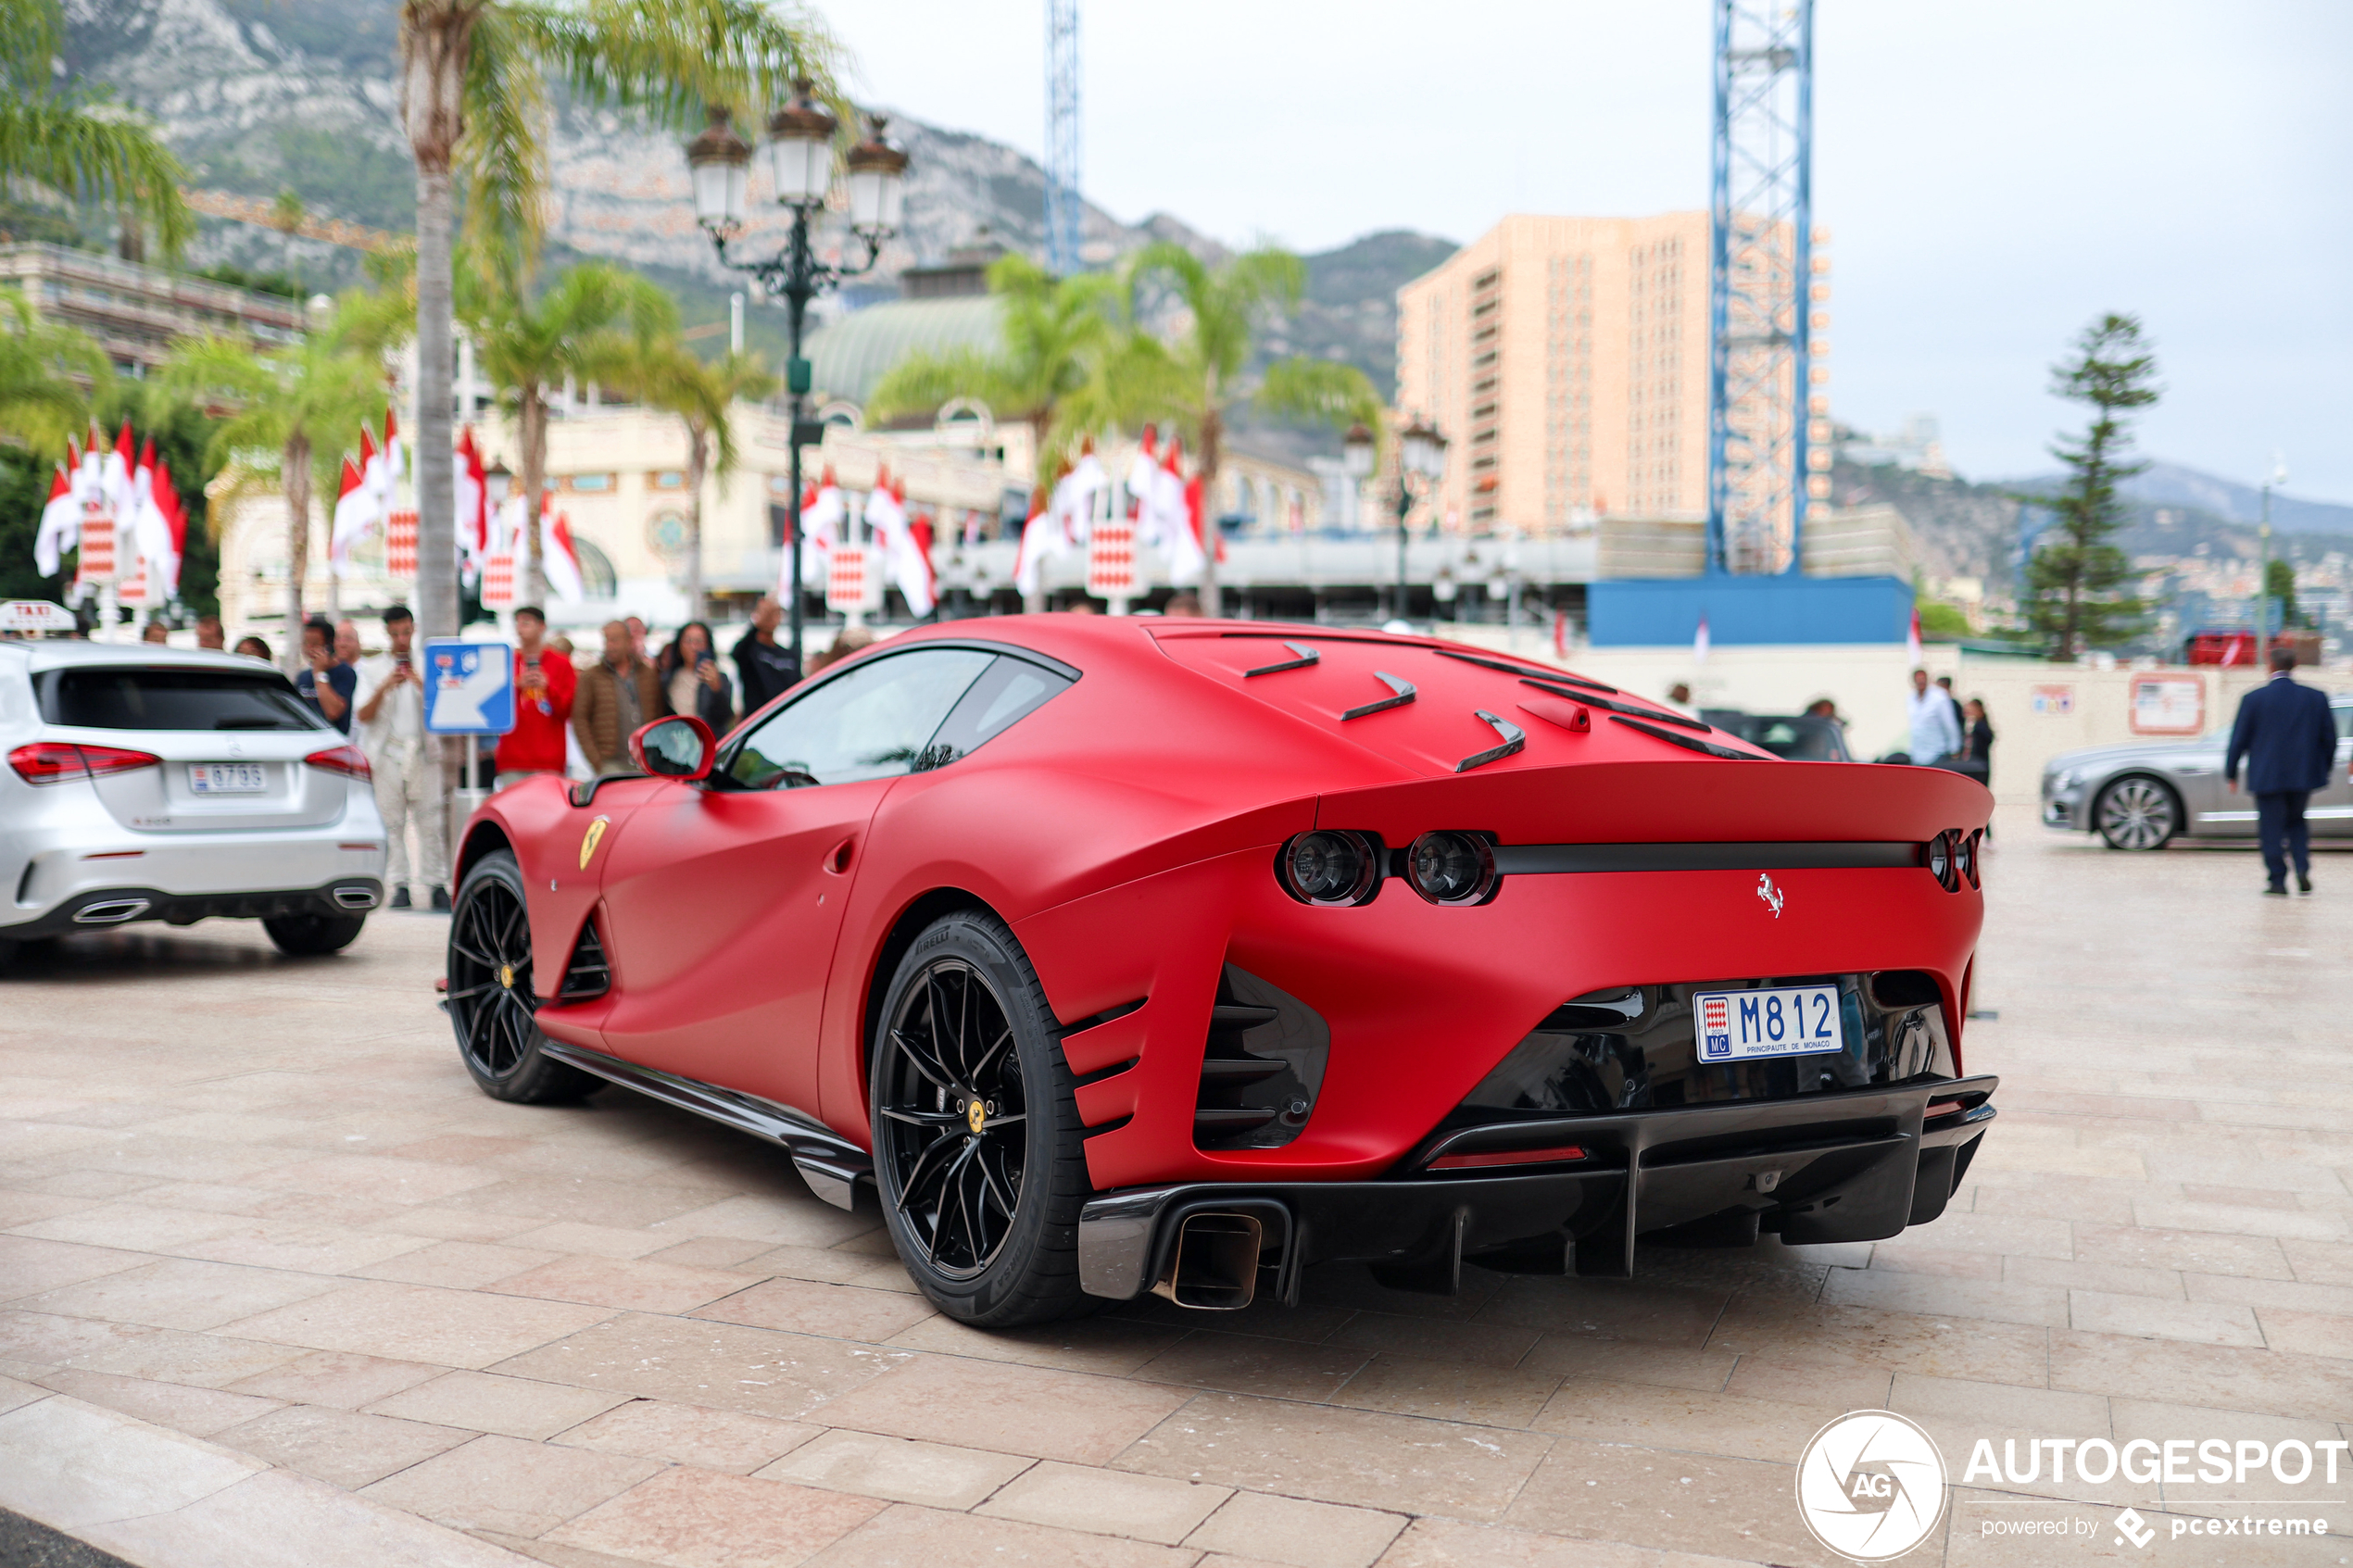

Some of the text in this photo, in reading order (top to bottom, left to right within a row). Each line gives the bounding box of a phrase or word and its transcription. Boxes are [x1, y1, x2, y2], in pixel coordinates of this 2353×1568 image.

[16, 606, 50, 616] TAXI
[914, 924, 950, 957] PIRELLI
[1740, 993, 1832, 1044] M812
[1711, 1036, 1726, 1052] MC
[1746, 1039, 1831, 1054] PRINCIPAUTE DE MONACO
